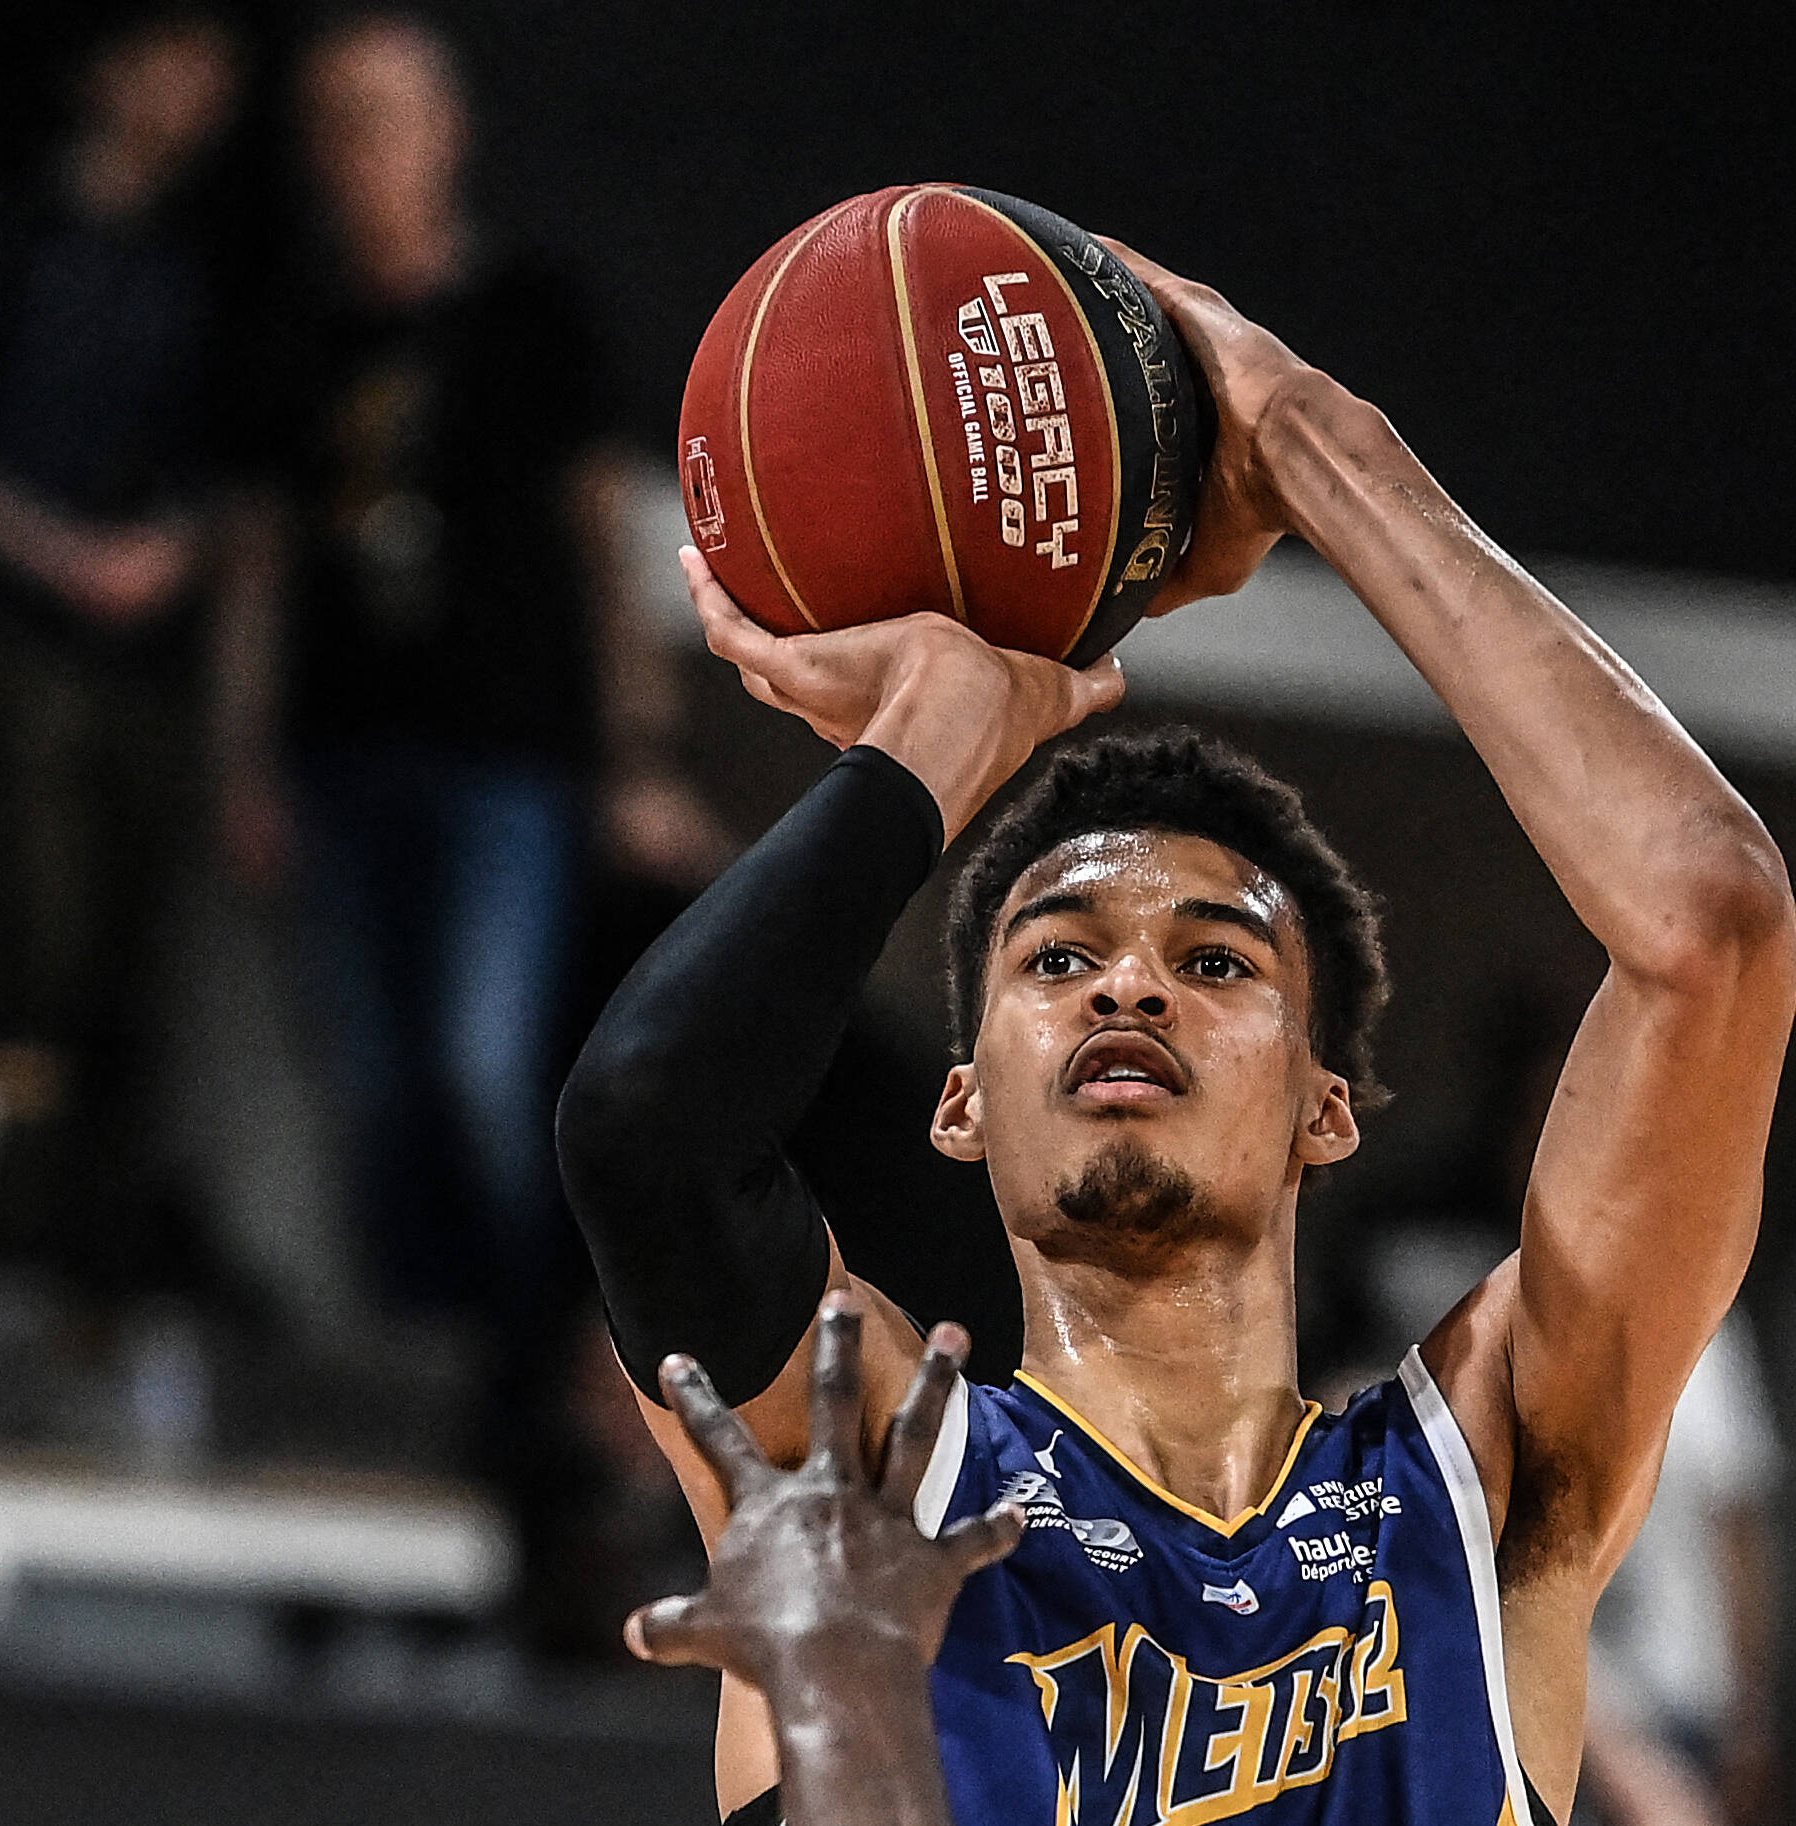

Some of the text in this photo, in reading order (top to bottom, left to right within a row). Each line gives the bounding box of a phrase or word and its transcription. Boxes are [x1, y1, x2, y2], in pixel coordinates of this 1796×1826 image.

[947, 352, 990, 504] OFFICIAL GAME BALL
[982, 271, 1080, 571] LEGACY
